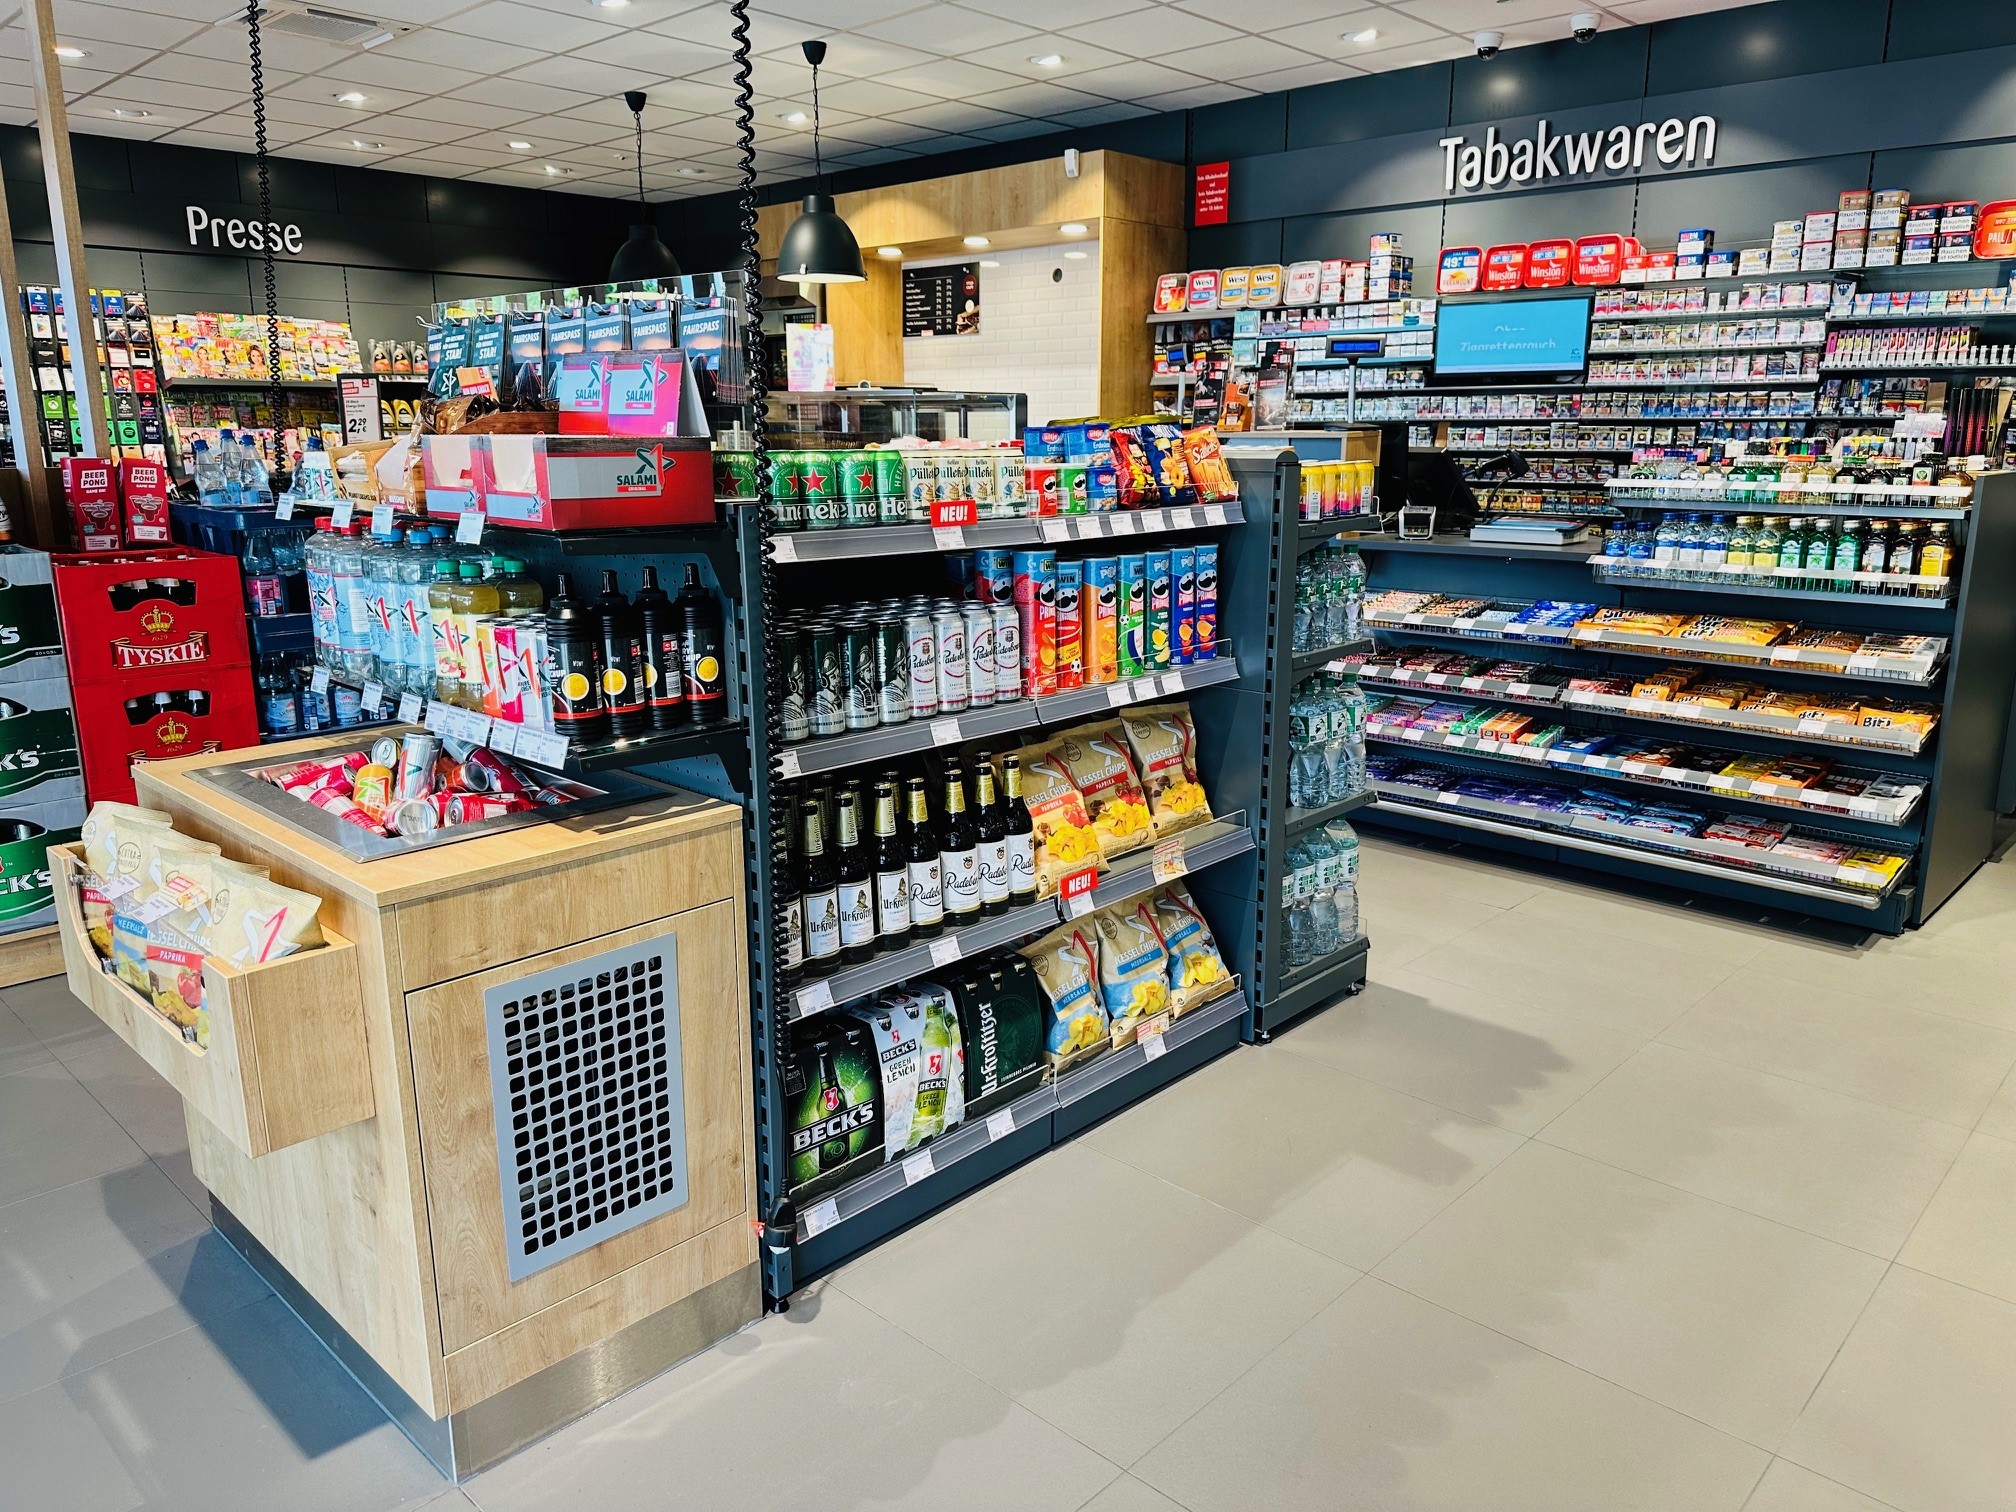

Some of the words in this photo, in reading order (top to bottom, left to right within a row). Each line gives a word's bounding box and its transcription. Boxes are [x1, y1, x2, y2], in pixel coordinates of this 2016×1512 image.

[1439, 116, 1716, 190] Tabakwaren
[186, 206, 304, 253] Presse
[1488, 270, 1516, 281] Winston
[1531, 266, 1561, 278] Winston
[1579, 263, 1610, 275] Winston
[1195, 278, 1212, 286] West
[1228, 275, 1246, 284] West
[1256, 274, 1274, 282] West
[588, 325, 620, 340] FAHRSPASS
[634, 322, 666, 337] FAHRSPASS
[682, 320, 720, 336] FAHRSPASS
[513, 332, 540, 344] FAHRSPASS
[551, 329, 580, 342] FAHRSPASS
[479, 346, 497, 360] STAR!
[576, 389, 600, 400] SALAMI
[626, 390, 653, 402] SALAMI
[616, 474, 657, 486] SALAMI
[940, 505, 968, 522] NEU!
[118, 640, 205, 668] TYSKIE
[1862, 716, 1891, 728] BiFi
[1145, 748, 1171, 763] KESSEL
[1078, 772, 1105, 787] KESSEL
[1106, 762, 1127, 776] CHIPS
[1050, 784, 1072, 798] CHIPS
[1096, 779, 1116, 790] PAPRIKA
[1041, 800, 1064, 812] PAPRIKA
[1068, 873, 1091, 894] NEU!
[1178, 914, 1196, 928] CHIPS
[160, 951, 186, 964] PAPRIKA
[1114, 946, 1141, 964] KESSEL
[1141, 938, 1158, 952] CHIPS
[1130, 954, 1152, 969] MEERSALZ
[1062, 986, 1087, 1004] MEERSALZ
[882, 1040, 916, 1061] BECK'S
[890, 1057, 912, 1073] GREEN
[886, 1063, 916, 1084] LEMON
[919, 1080, 946, 1092] BECK'S
[794, 1102, 874, 1152] BECK'S
